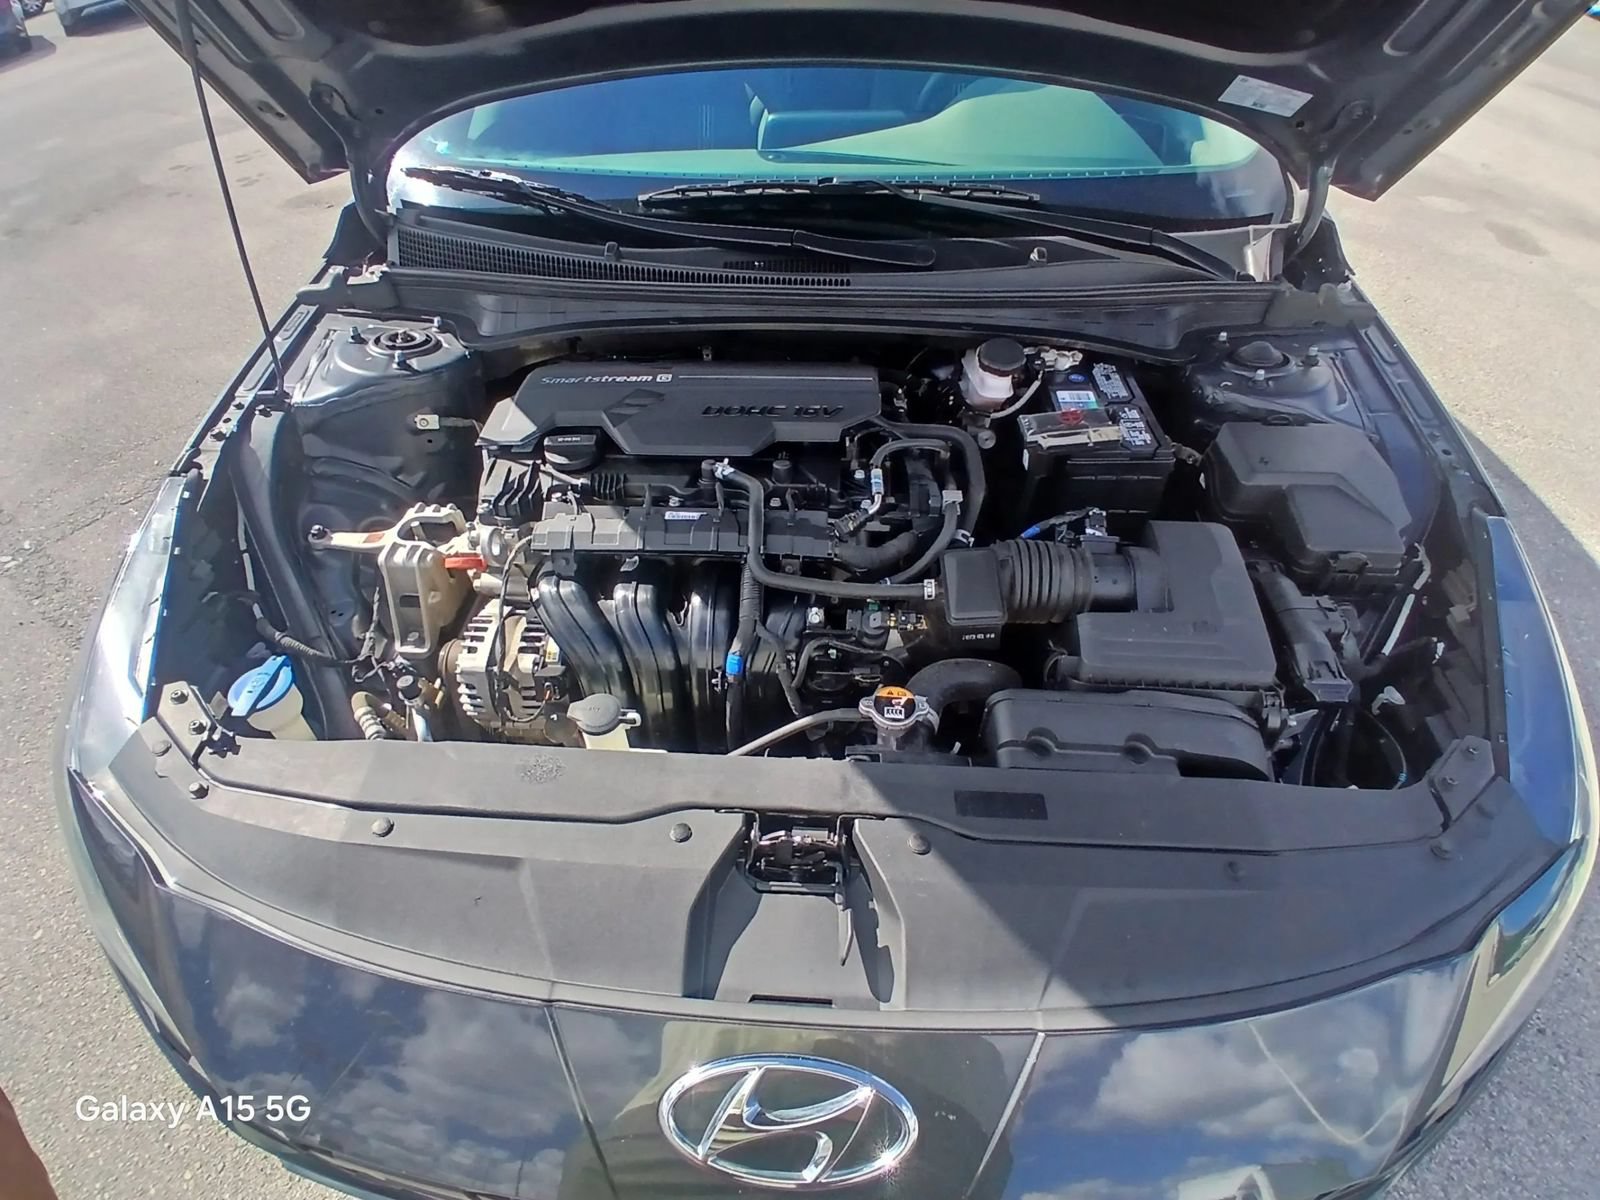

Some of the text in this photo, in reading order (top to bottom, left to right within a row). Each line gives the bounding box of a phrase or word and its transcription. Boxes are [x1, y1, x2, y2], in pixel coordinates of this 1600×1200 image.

[540, 375, 653, 385] Smartstream
[701, 404, 844, 418] DOHC 16V
